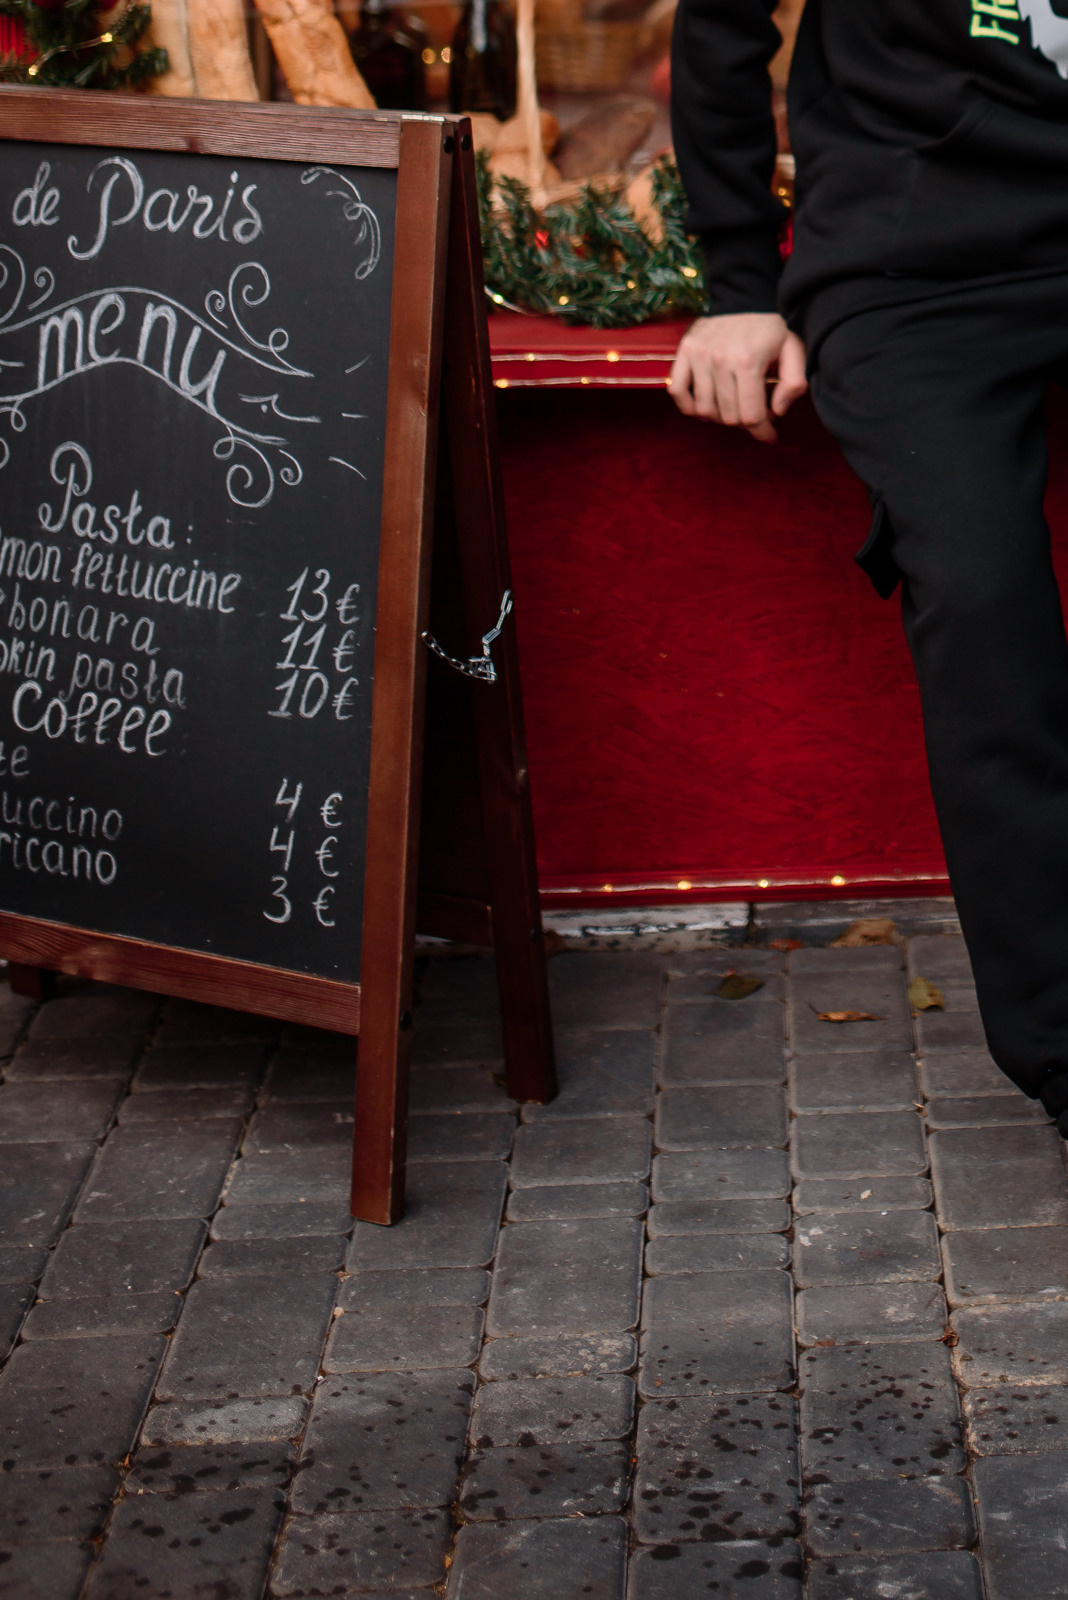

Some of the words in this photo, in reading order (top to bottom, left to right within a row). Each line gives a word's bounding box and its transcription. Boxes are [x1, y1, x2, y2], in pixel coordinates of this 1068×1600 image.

[12, 160, 60, 226] de
[67, 156, 265, 260] Paris
[38, 294, 226, 414] menu
[0, 530, 62, 584] mon
[71, 542, 242, 614] fettuccine
[0, 582, 160, 656] bonara
[59, 652, 188, 710] pasta
[12, 680, 173, 757] Coffee
[274, 777, 303, 823] 4
[269, 826, 296, 872] 4
[262, 876, 292, 923] 3
